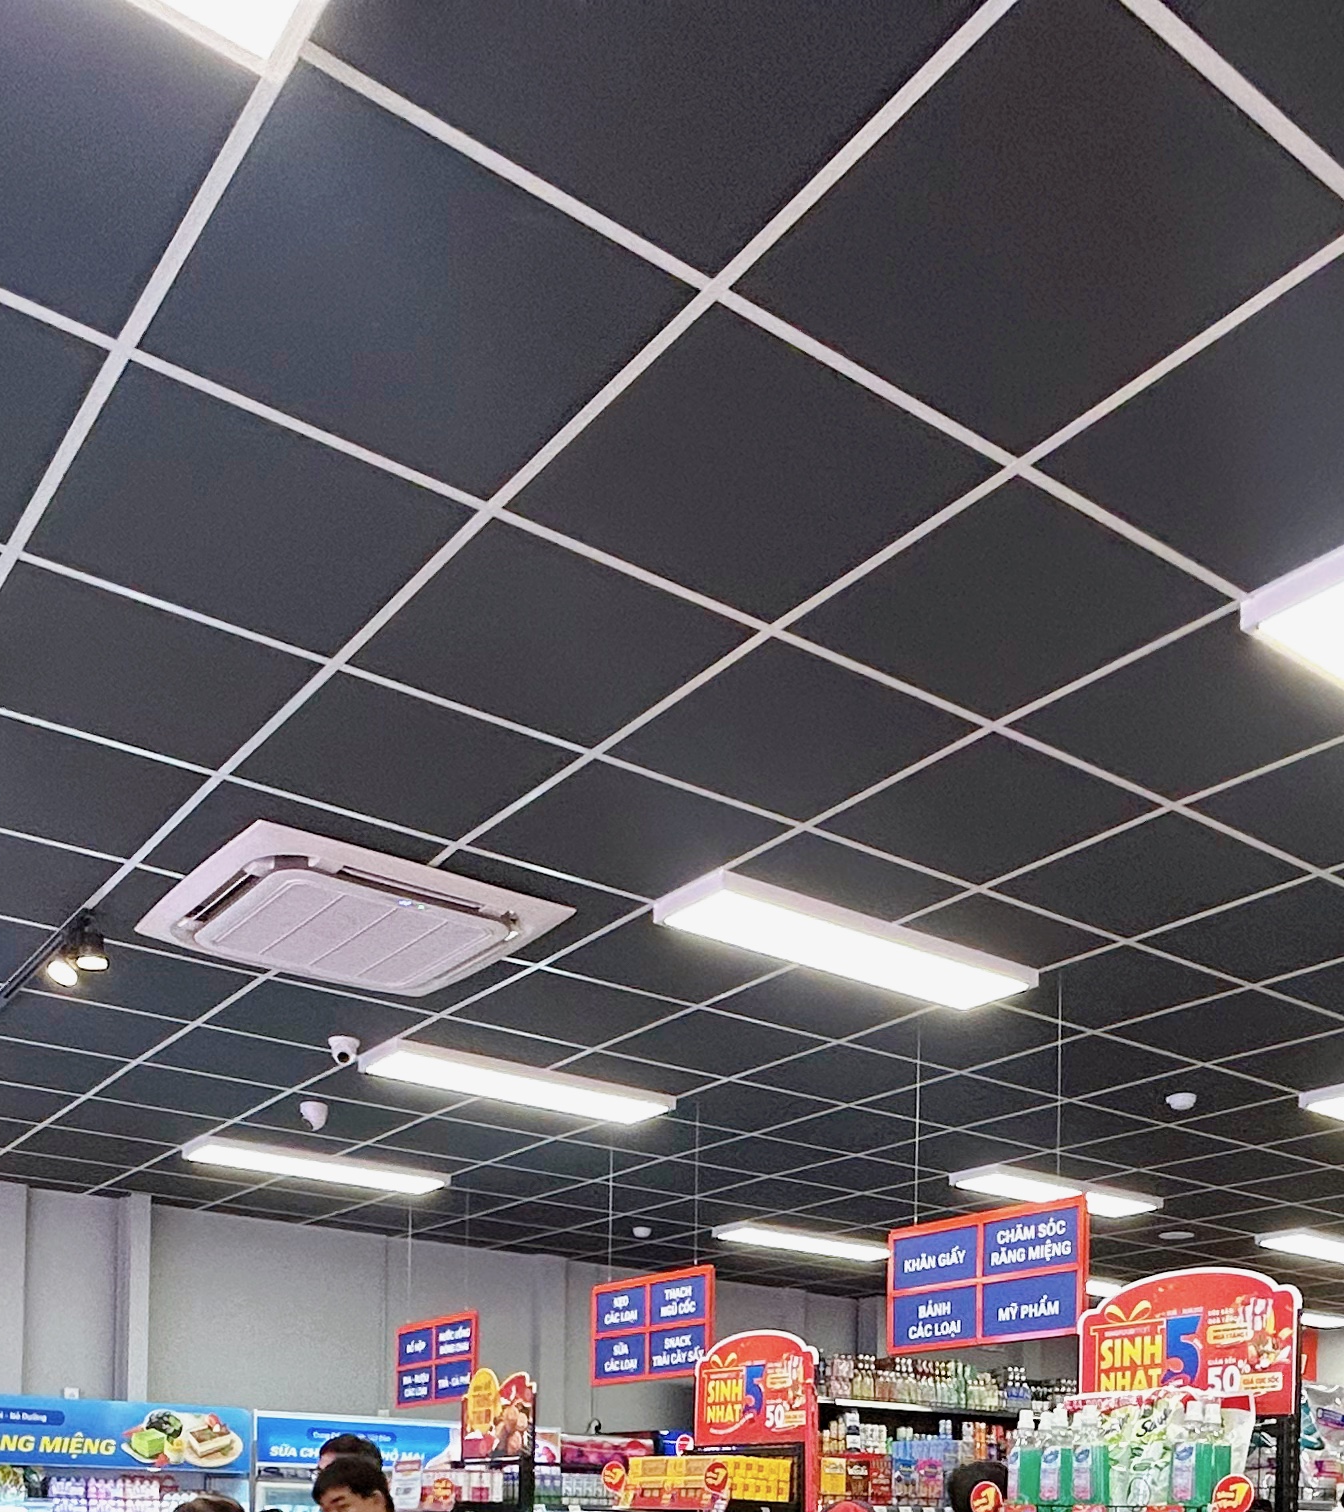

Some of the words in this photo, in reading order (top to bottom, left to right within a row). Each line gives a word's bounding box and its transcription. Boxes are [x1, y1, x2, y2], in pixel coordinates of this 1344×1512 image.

[996, 1226, 1036, 1245] CHĂM
[1037, 1217, 1067, 1239] SÓC
[903, 1256, 936, 1274] KHĂN
[938, 1245, 967, 1267] GIẤY
[990, 1246, 1026, 1267] RĂNG
[1027, 1240, 1073, 1263] MIỆNG
[918, 1299, 951, 1319] BÁNH
[997, 1302, 1018, 1322] MỸ
[1020, 1294, 1060, 1318] PHẨM
[908, 1322, 933, 1340] CÁC
[934, 1319, 961, 1338] LOẠI
[1099, 1333, 1163, 1369] SINH
[1160, 1315, 1202, 1386] 5
[707, 1377, 742, 1403] SINH
[744, 1364, 766, 1417] 5
[39, 1431, 116, 1459] MIỆNG
[269, 1443, 297, 1458] SỮA
